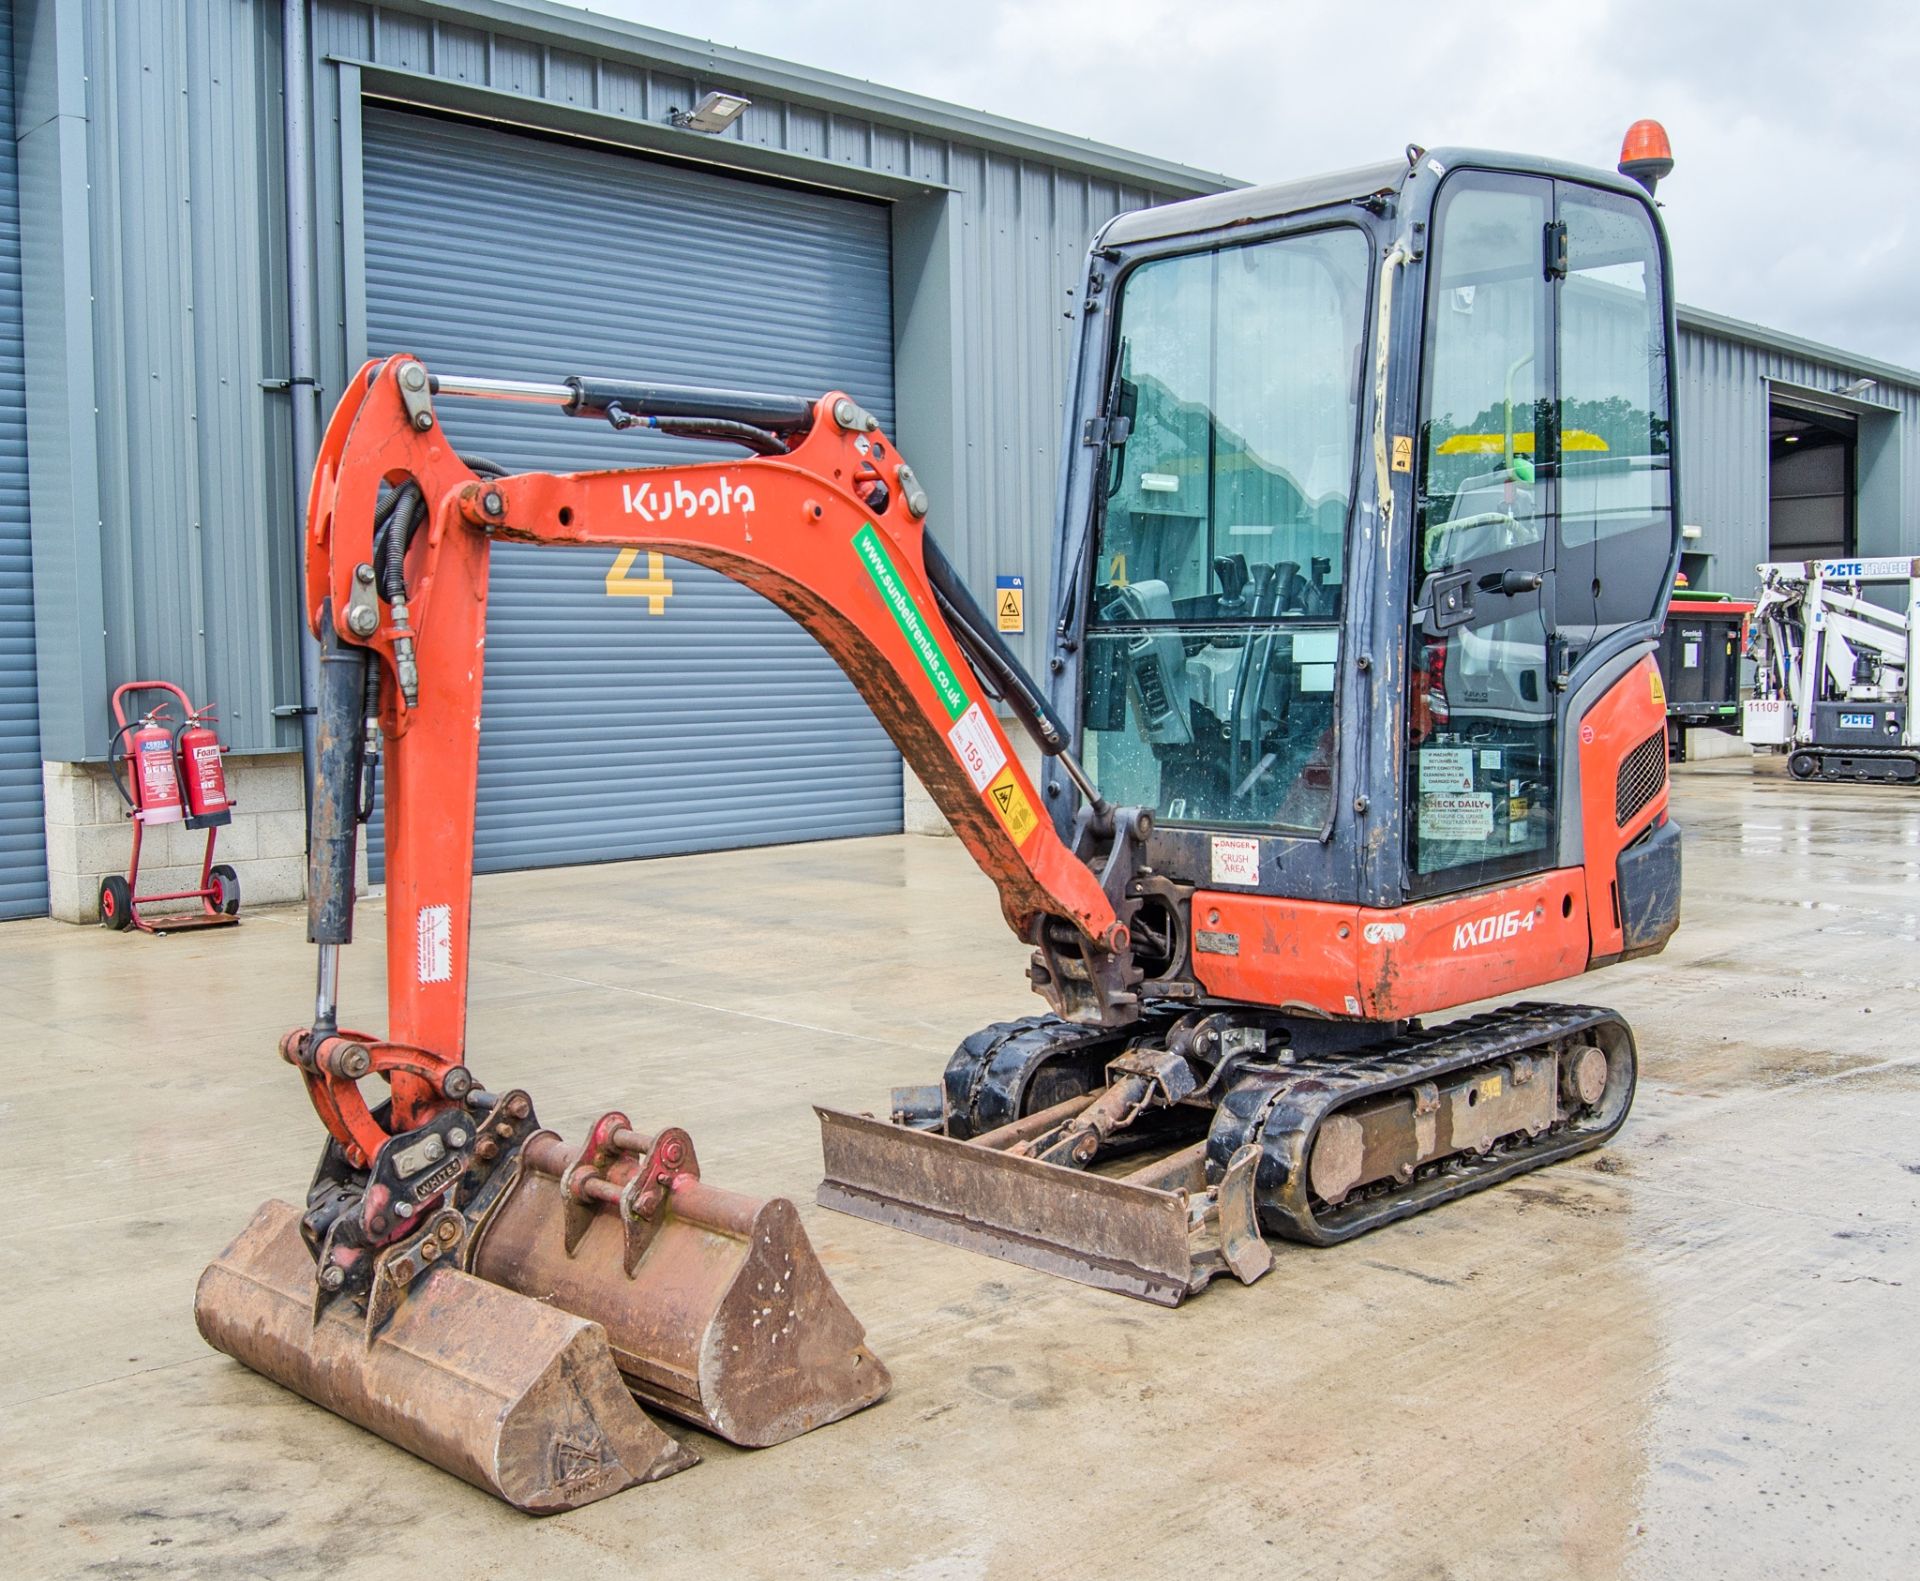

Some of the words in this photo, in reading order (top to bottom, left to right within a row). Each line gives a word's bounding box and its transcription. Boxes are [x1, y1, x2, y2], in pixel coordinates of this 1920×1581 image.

[622, 476, 755, 522] Kubota
[1837, 563, 1862, 576] CTE
[605, 547, 673, 615] 4
[861, 535, 963, 709] www.sunbeltrentals.co.uk
[1748, 703, 1779, 712] 11109
[1851, 714, 1872, 725] CTE
[196, 748, 217, 758] Foam
[964, 739, 983, 772] 159
[1457, 800, 1485, 808] DAILY
[1220, 841, 1250, 849] DANGER
[1221, 853, 1249, 863] CRUSH
[1224, 864, 1246, 873] AREA
[1452, 910, 1534, 951] KX016-4
[418, 1161, 460, 1195] WHITES
